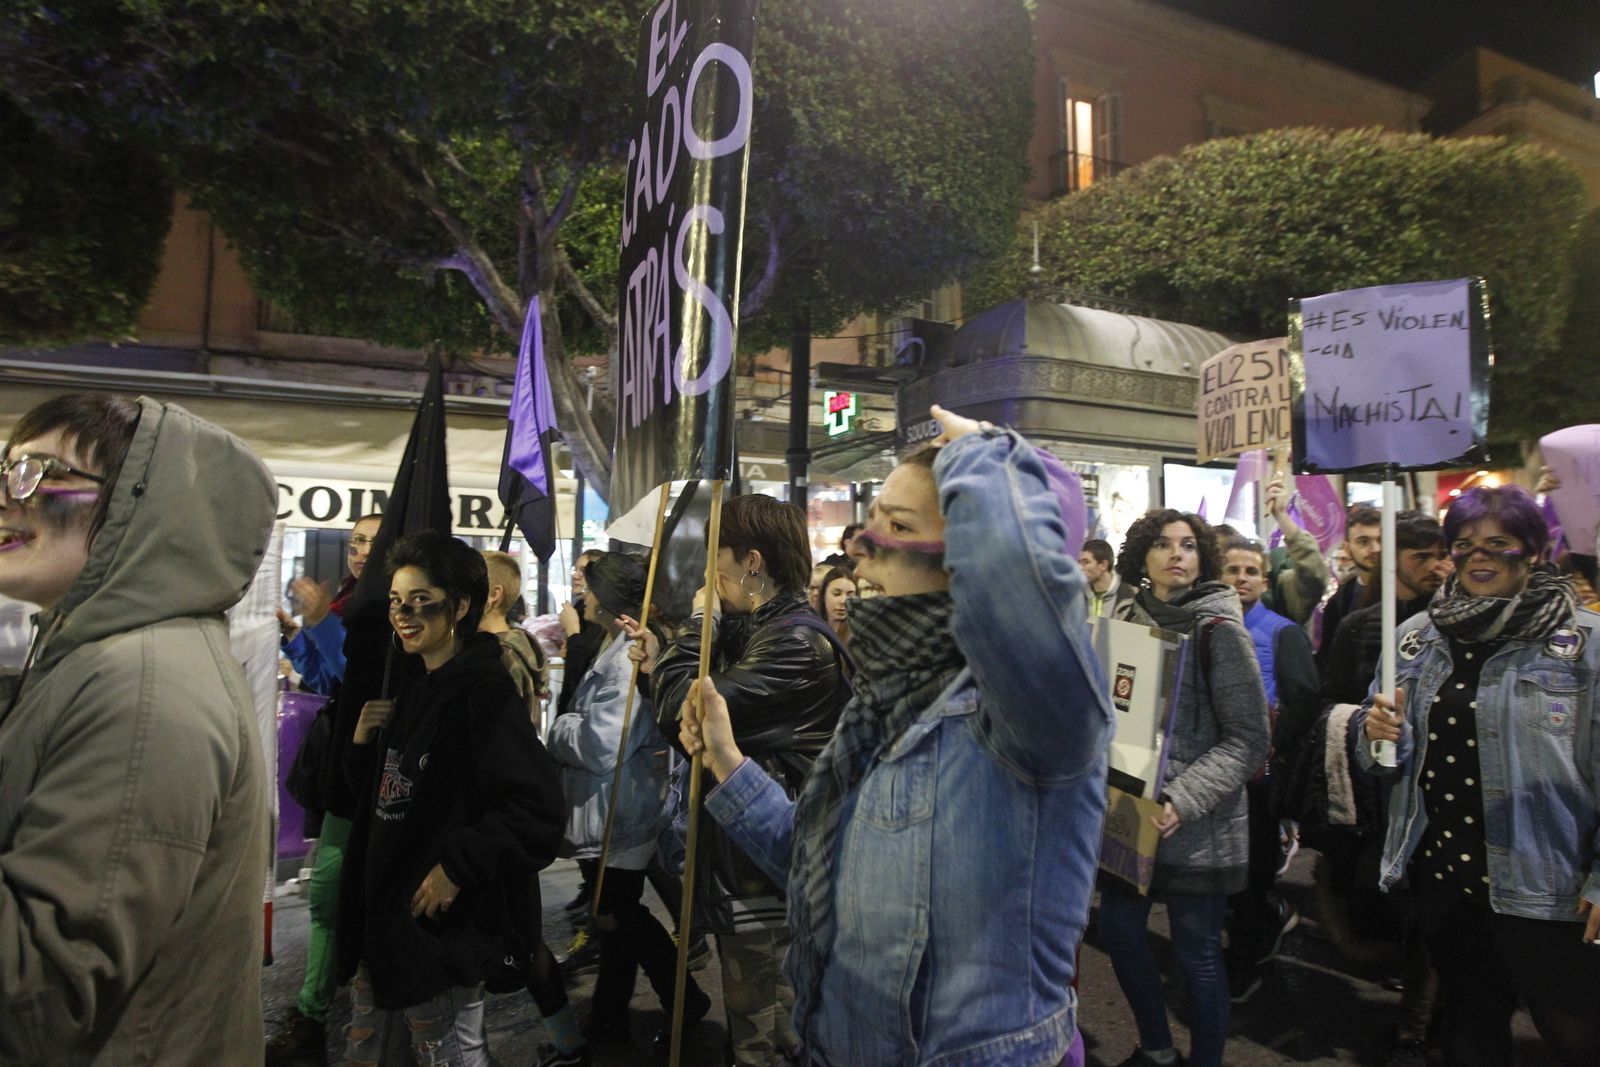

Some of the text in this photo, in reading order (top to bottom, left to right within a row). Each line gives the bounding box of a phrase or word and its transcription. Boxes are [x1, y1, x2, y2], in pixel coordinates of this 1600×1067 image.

[647, 0, 687, 97] EL
[620, 42, 753, 255] CADO
[622, 203, 732, 440] ATRÁS
[1205, 386, 1272, 418] CONTRA
